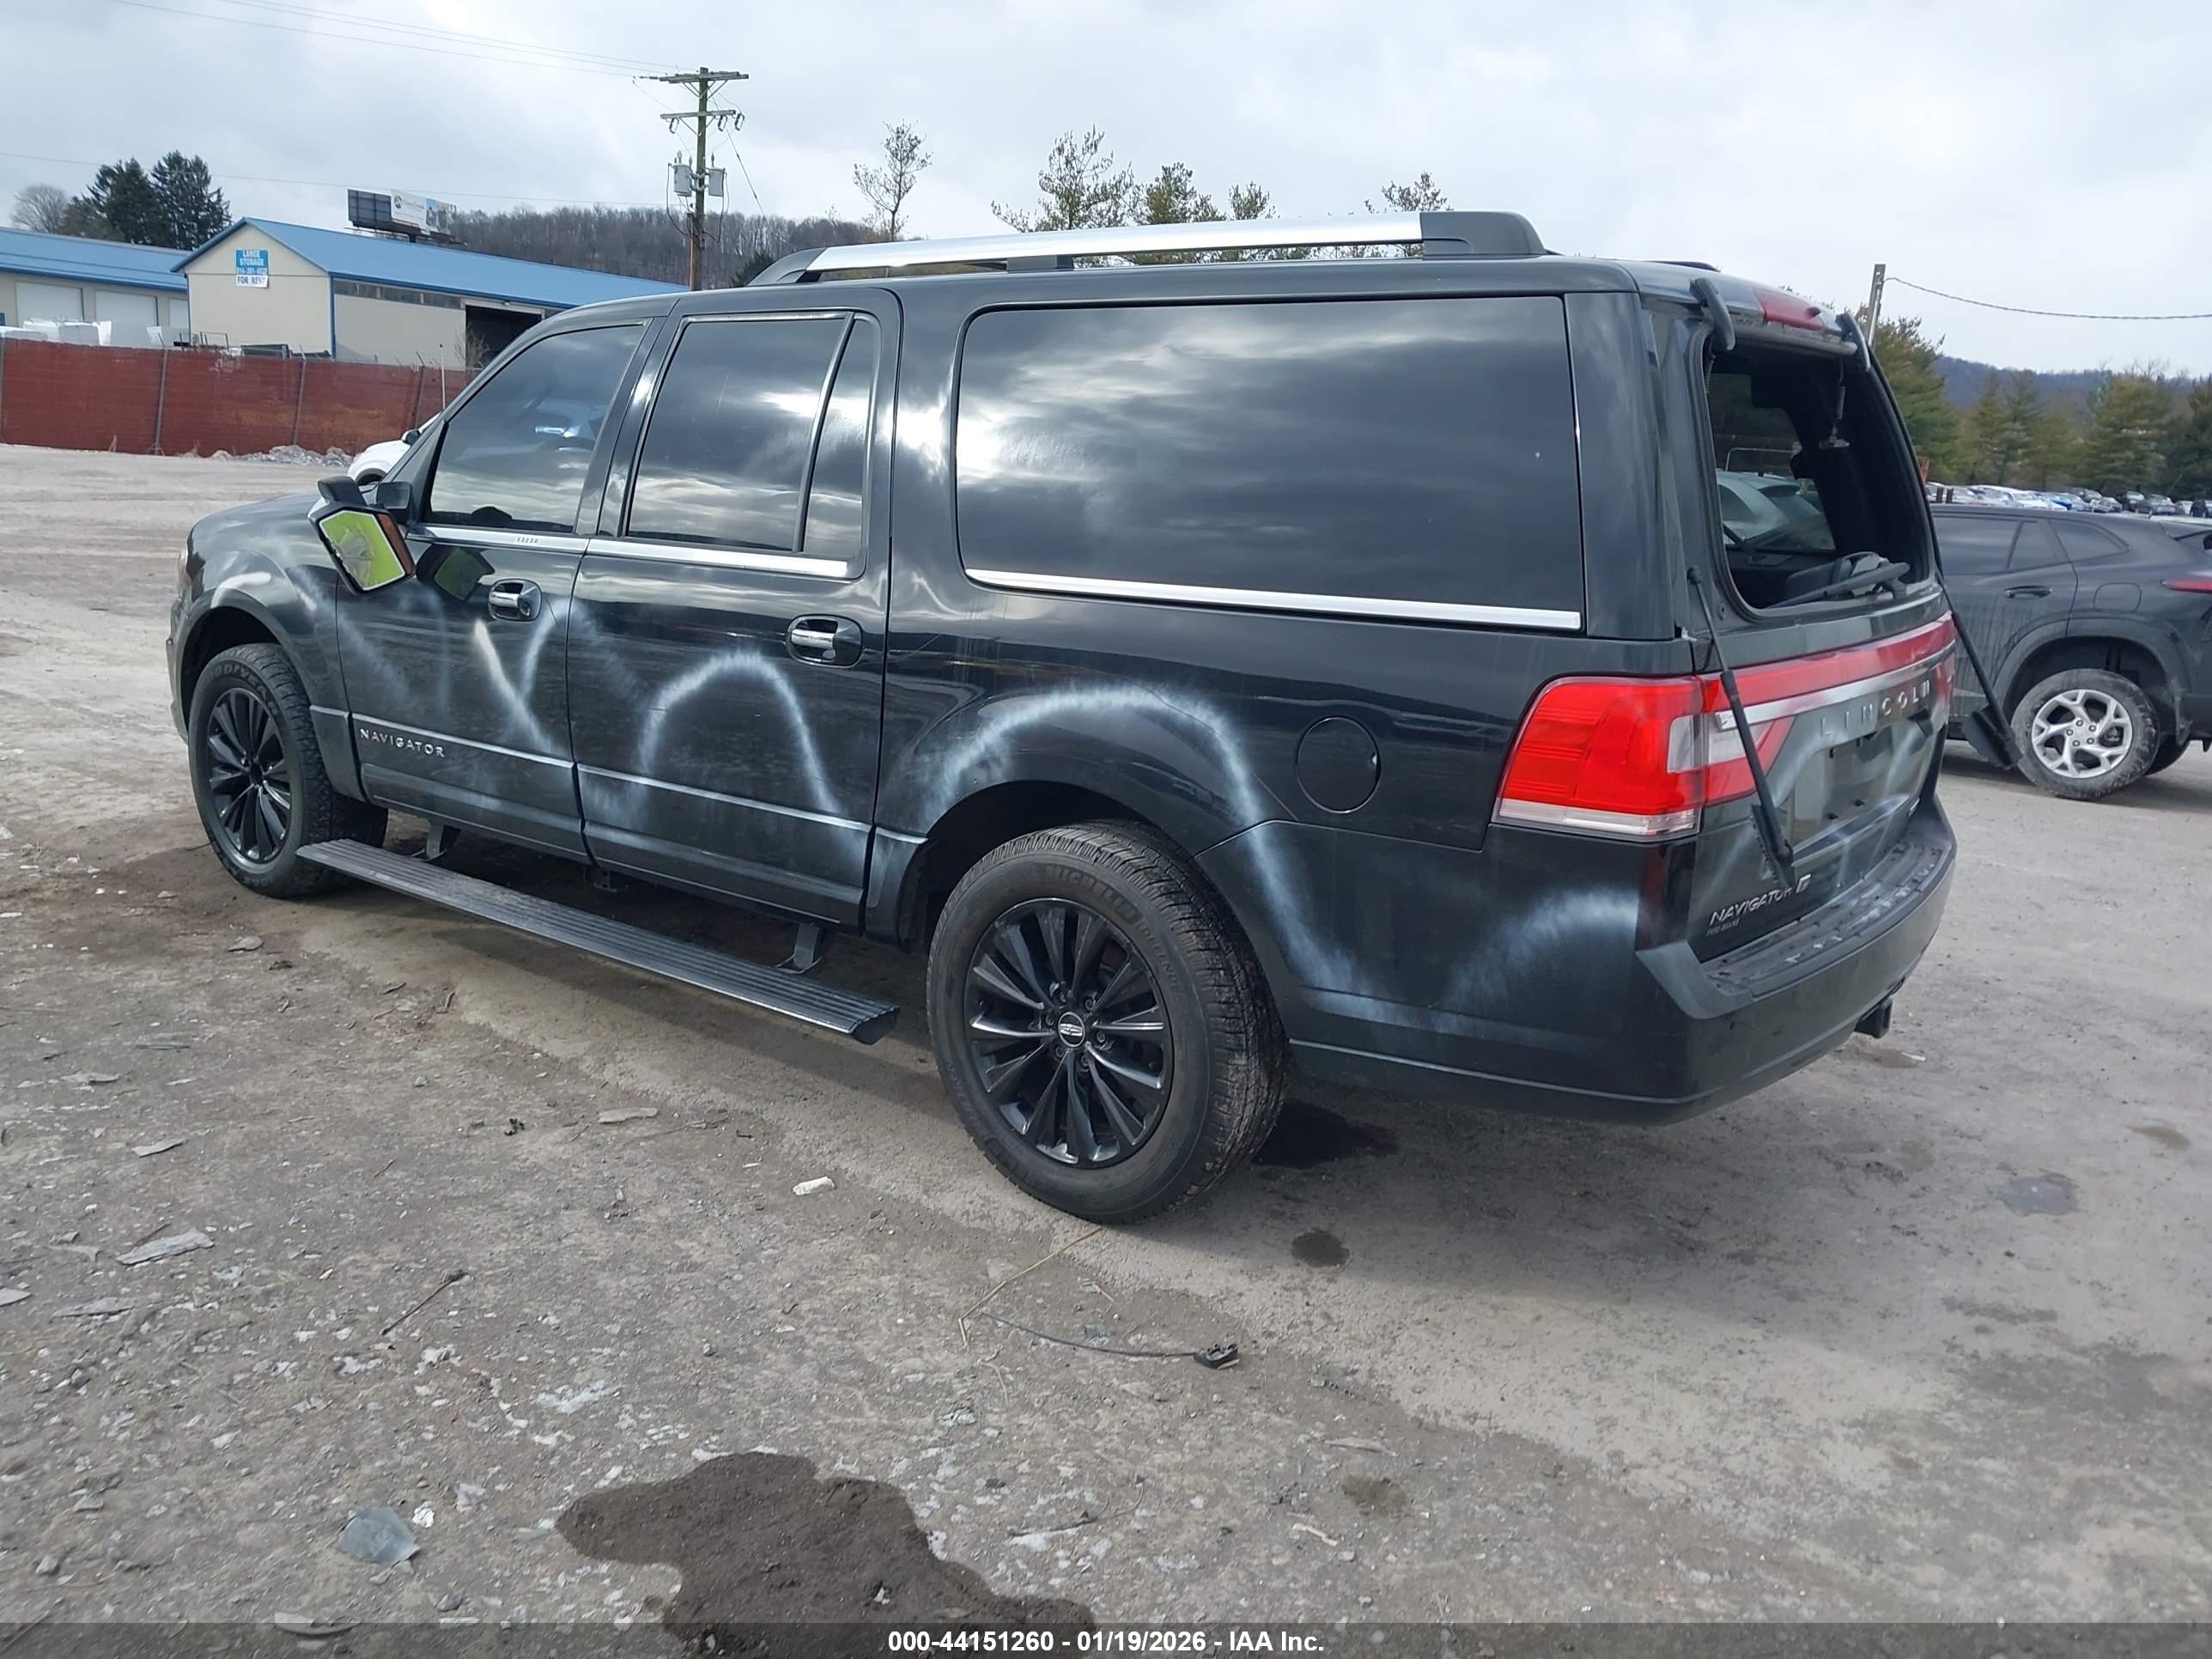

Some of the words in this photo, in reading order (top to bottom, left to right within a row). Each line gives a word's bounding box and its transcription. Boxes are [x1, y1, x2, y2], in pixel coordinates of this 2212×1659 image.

[237, 276, 249, 284] FOR
[1821, 680, 1930, 736] LINCOLN
[360, 728, 445, 757] NAVIGATOR
